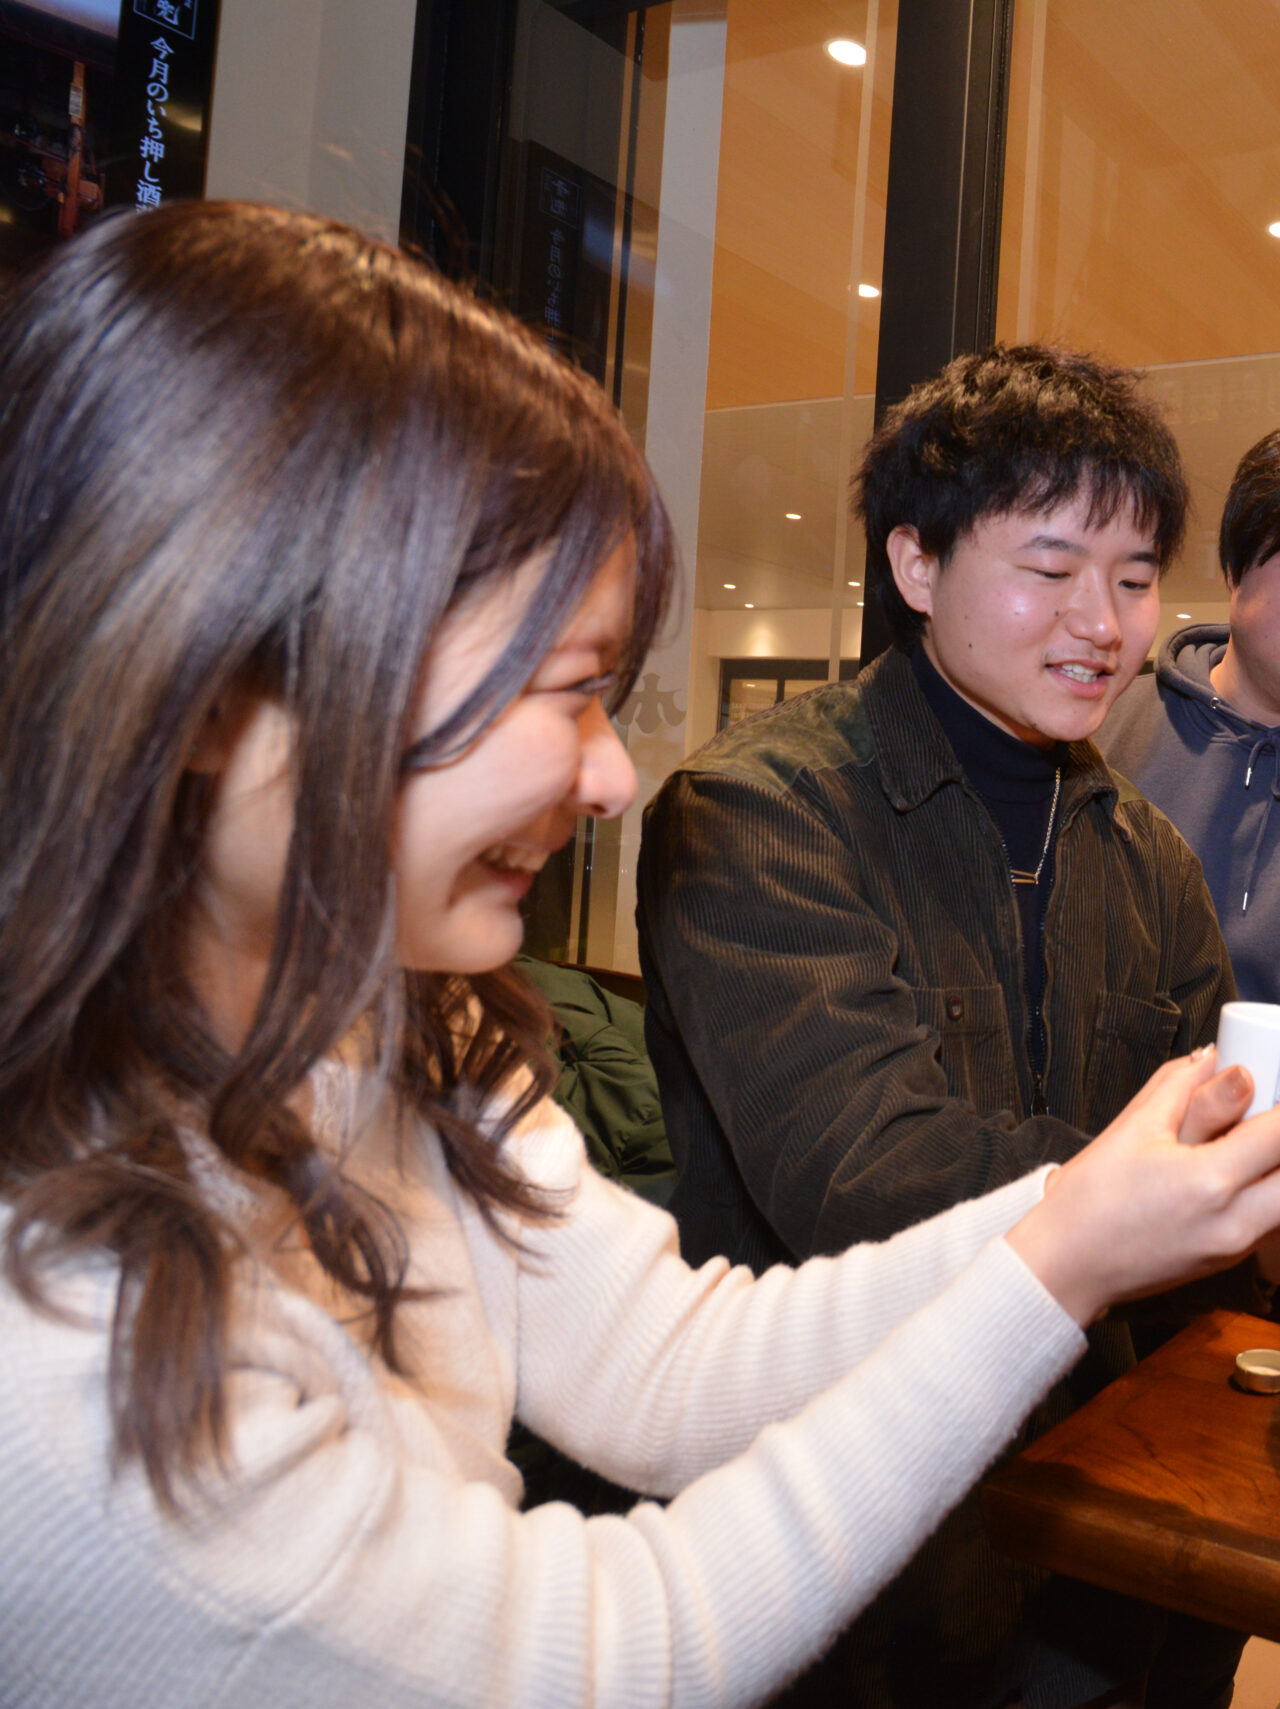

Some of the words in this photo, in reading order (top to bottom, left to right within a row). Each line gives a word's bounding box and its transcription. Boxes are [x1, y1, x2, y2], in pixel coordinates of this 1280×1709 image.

[135, 36, 175, 214] 今月のいち押し酒
